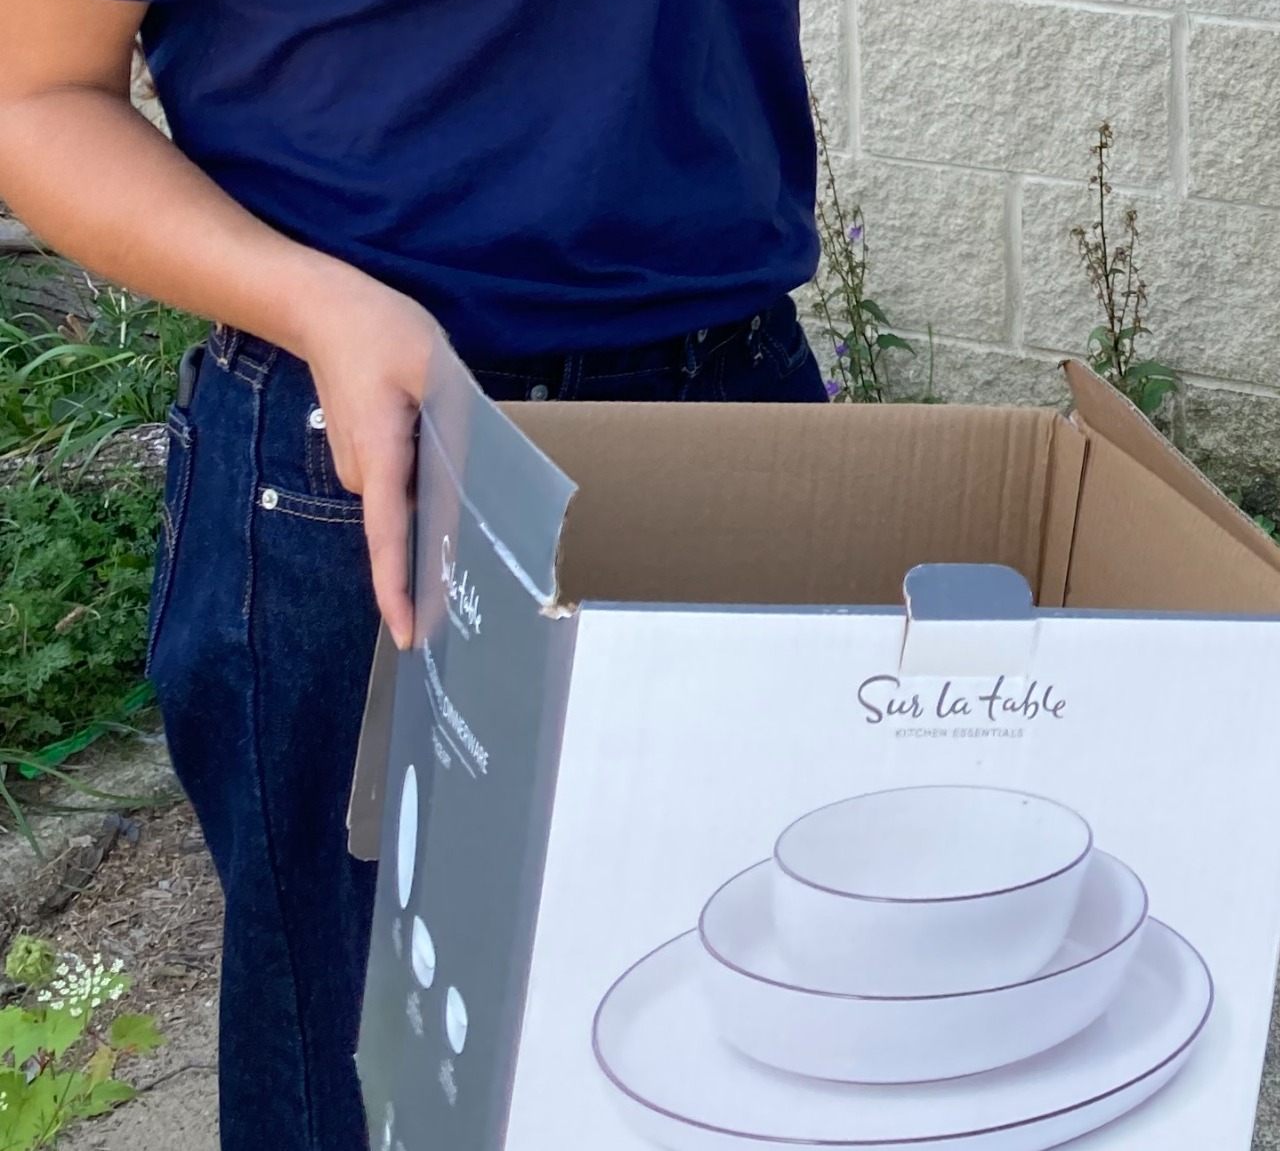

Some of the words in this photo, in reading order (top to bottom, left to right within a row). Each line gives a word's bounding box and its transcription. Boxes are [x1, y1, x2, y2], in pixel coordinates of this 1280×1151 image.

[857, 674, 925, 725] Sur
[935, 680, 973, 719] la
[978, 674, 1067, 722] table
[894, 727, 949, 739] KITCHEN
[952, 727, 1025, 739] ESSENTIALS
